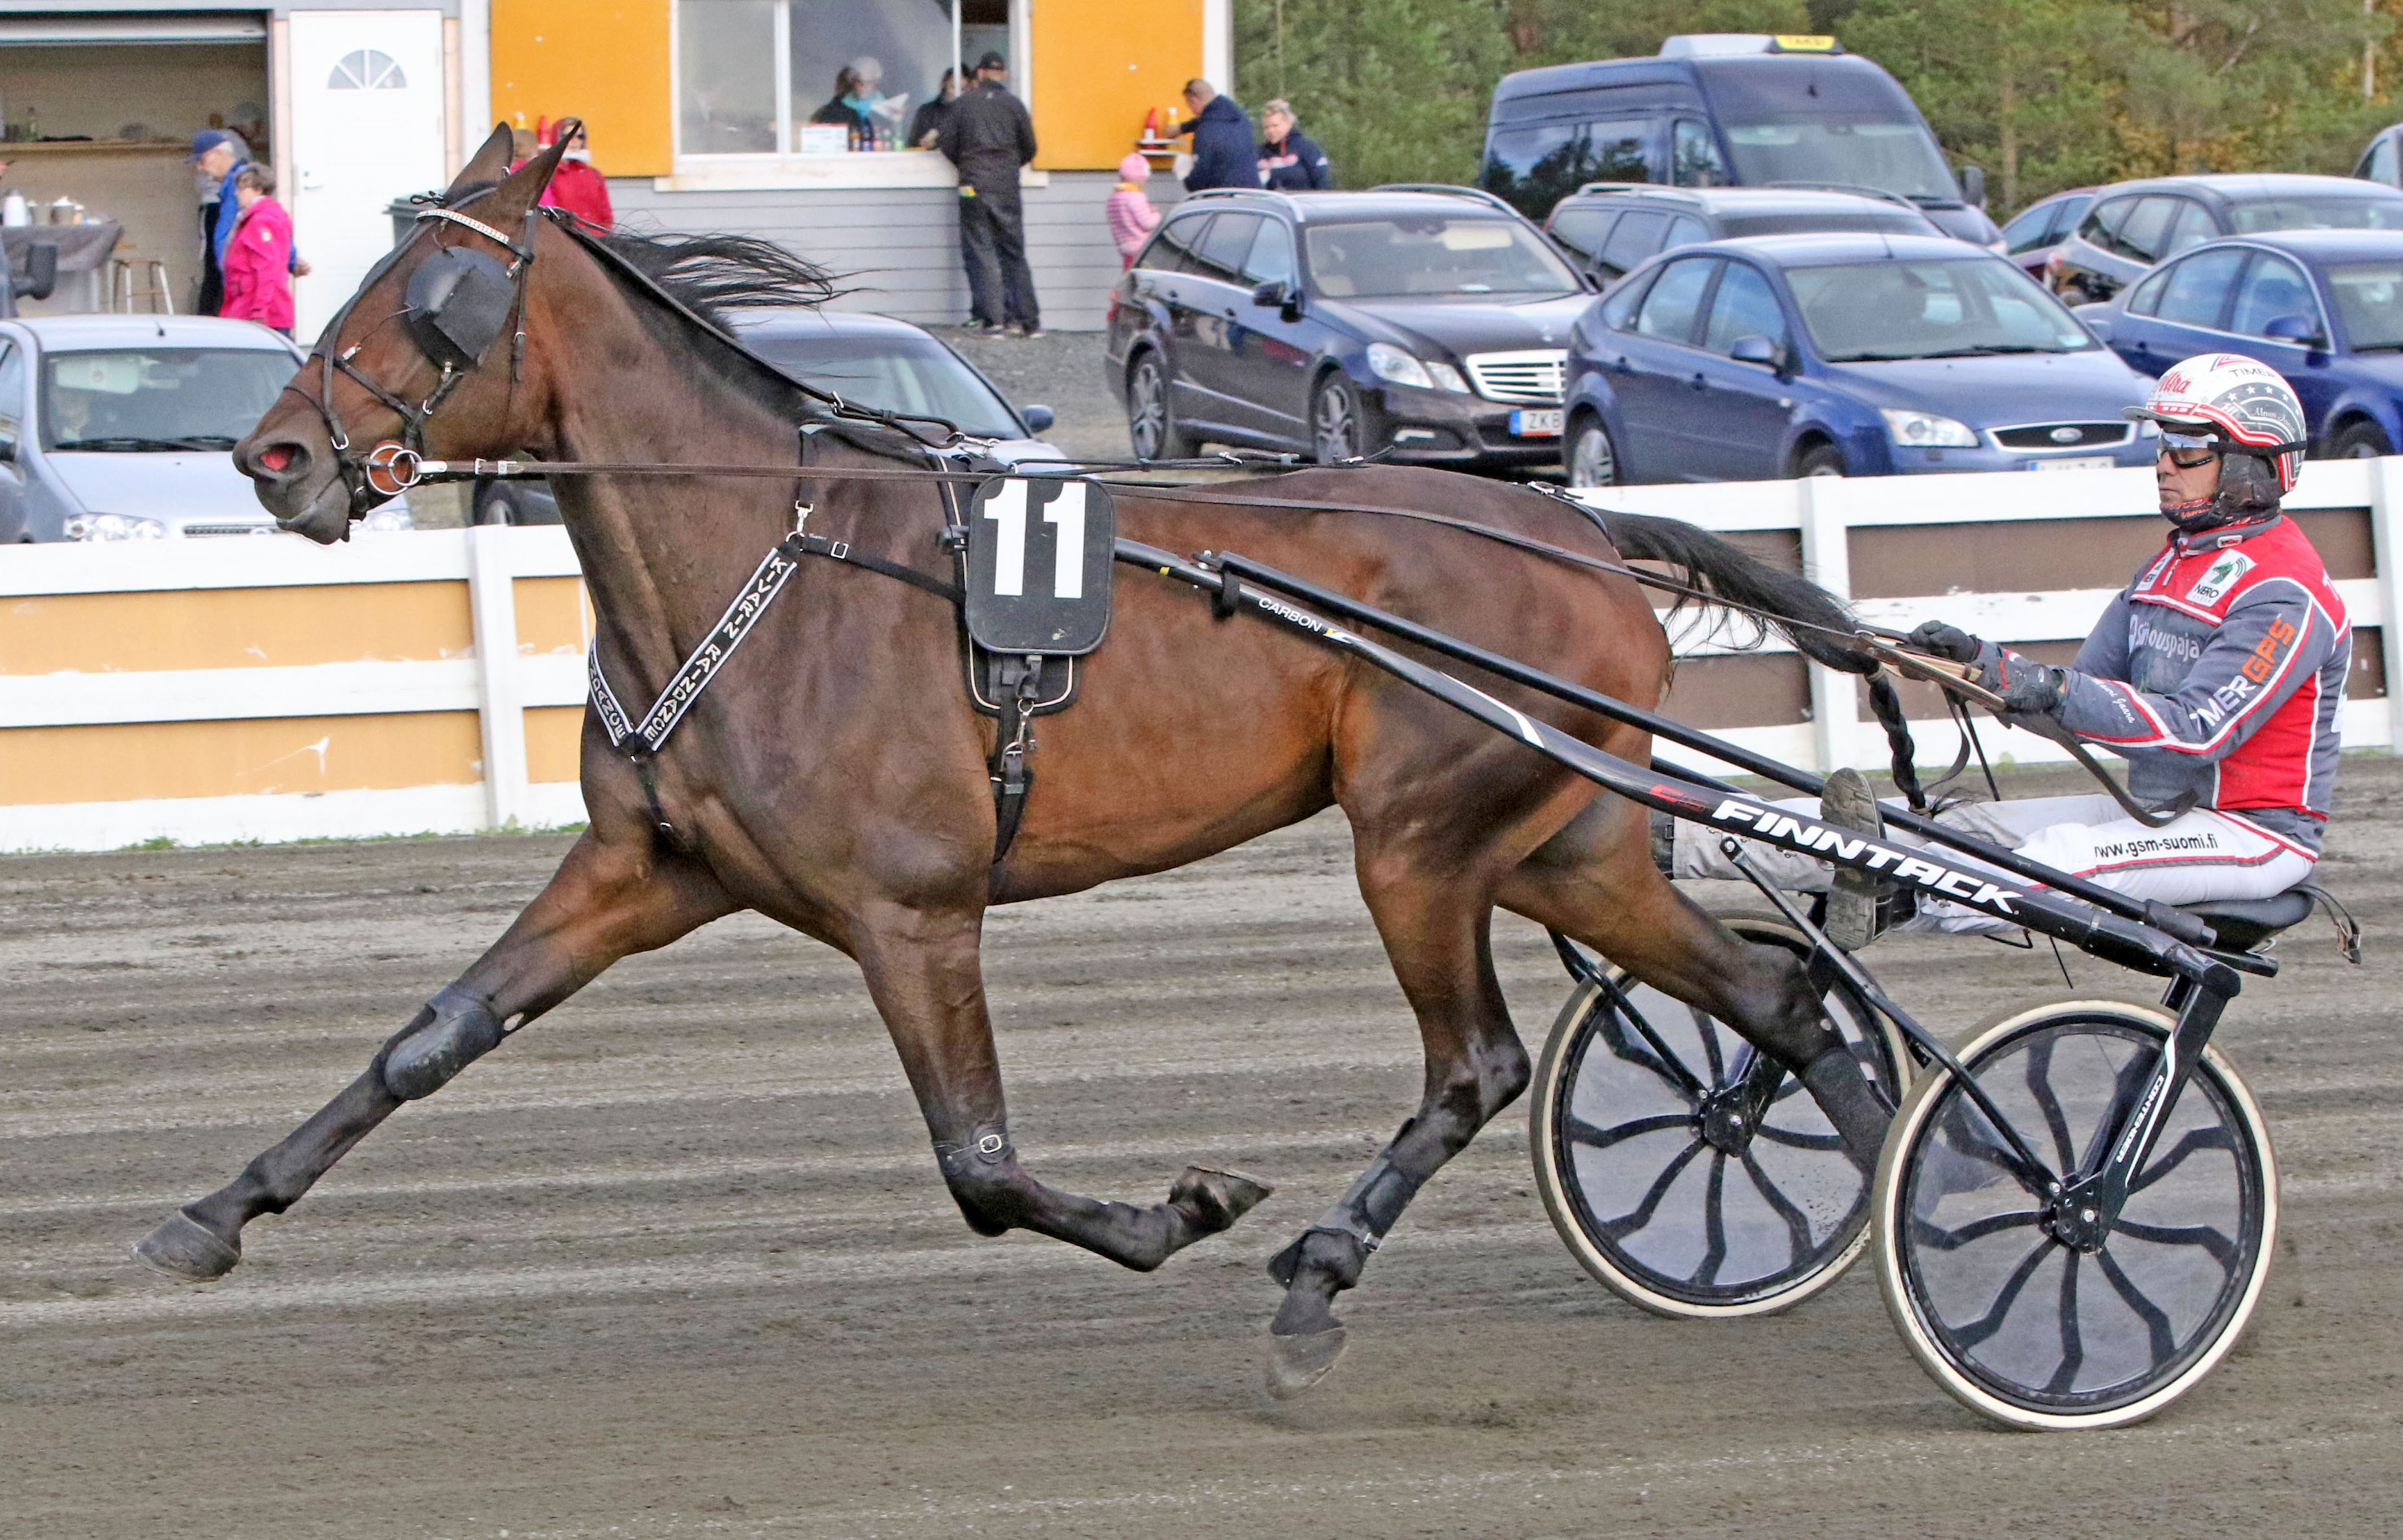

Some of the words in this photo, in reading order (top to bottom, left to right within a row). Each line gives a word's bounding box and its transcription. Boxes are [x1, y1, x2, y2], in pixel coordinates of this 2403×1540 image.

[984, 479, 1086, 599] 11
[723, 556, 788, 639] KIVARIN
[1258, 597, 1323, 632] CARBON
[2194, 584, 2219, 598] NERO
[643, 643, 721, 742] RAINDANCE
[1712, 800, 2024, 914] FINNTACK
[2117, 1074, 2164, 1163] CONTENDER
